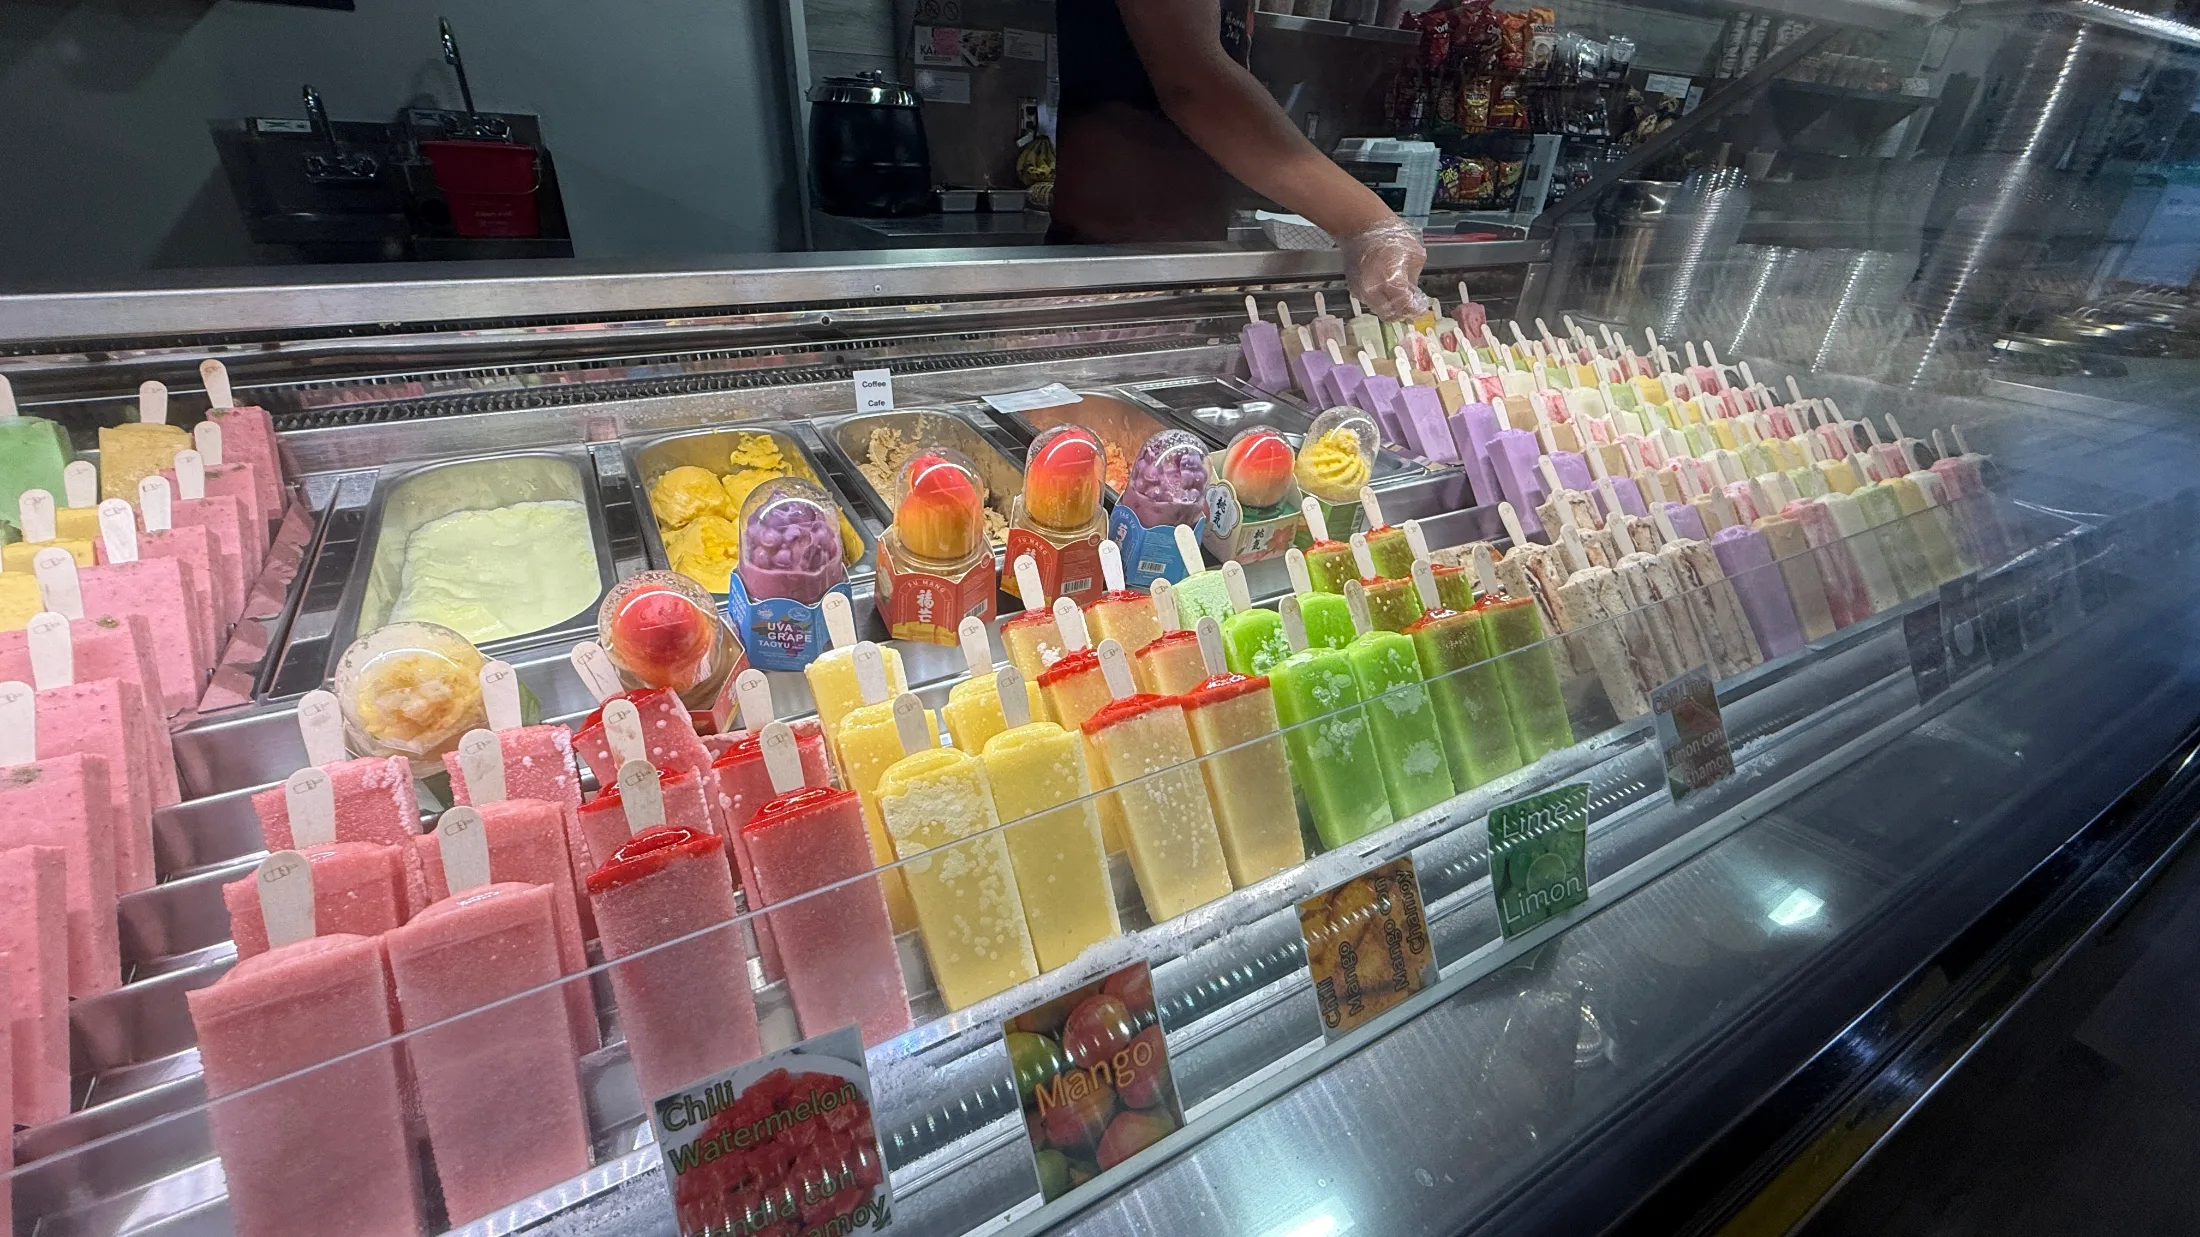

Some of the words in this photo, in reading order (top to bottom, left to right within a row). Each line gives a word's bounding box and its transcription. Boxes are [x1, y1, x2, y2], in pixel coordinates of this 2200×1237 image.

[862, 380, 887, 388] Coffee
[868, 399, 886, 407] Cafe
[907, 580, 919, 588] FU
[922, 580, 946, 593] MANG
[758, 639, 791, 649] TAOYU
[767, 621, 794, 632] UVA
[767, 631, 812, 643] GRAPE
[1701, 728, 1723, 748] con
[1503, 802, 1569, 839] Lime
[1396, 869, 1425, 954] Chamoy
[1502, 876, 1582, 924] Limon
[1384, 919, 1410, 992] Mango
[1338, 941, 1365, 1017] Mango
[1316, 976, 1342, 1029] Chili
[1034, 1040, 1153, 1118] Mango
[662, 1079, 736, 1132] Chili
[667, 1082, 858, 1175] Watermelon
